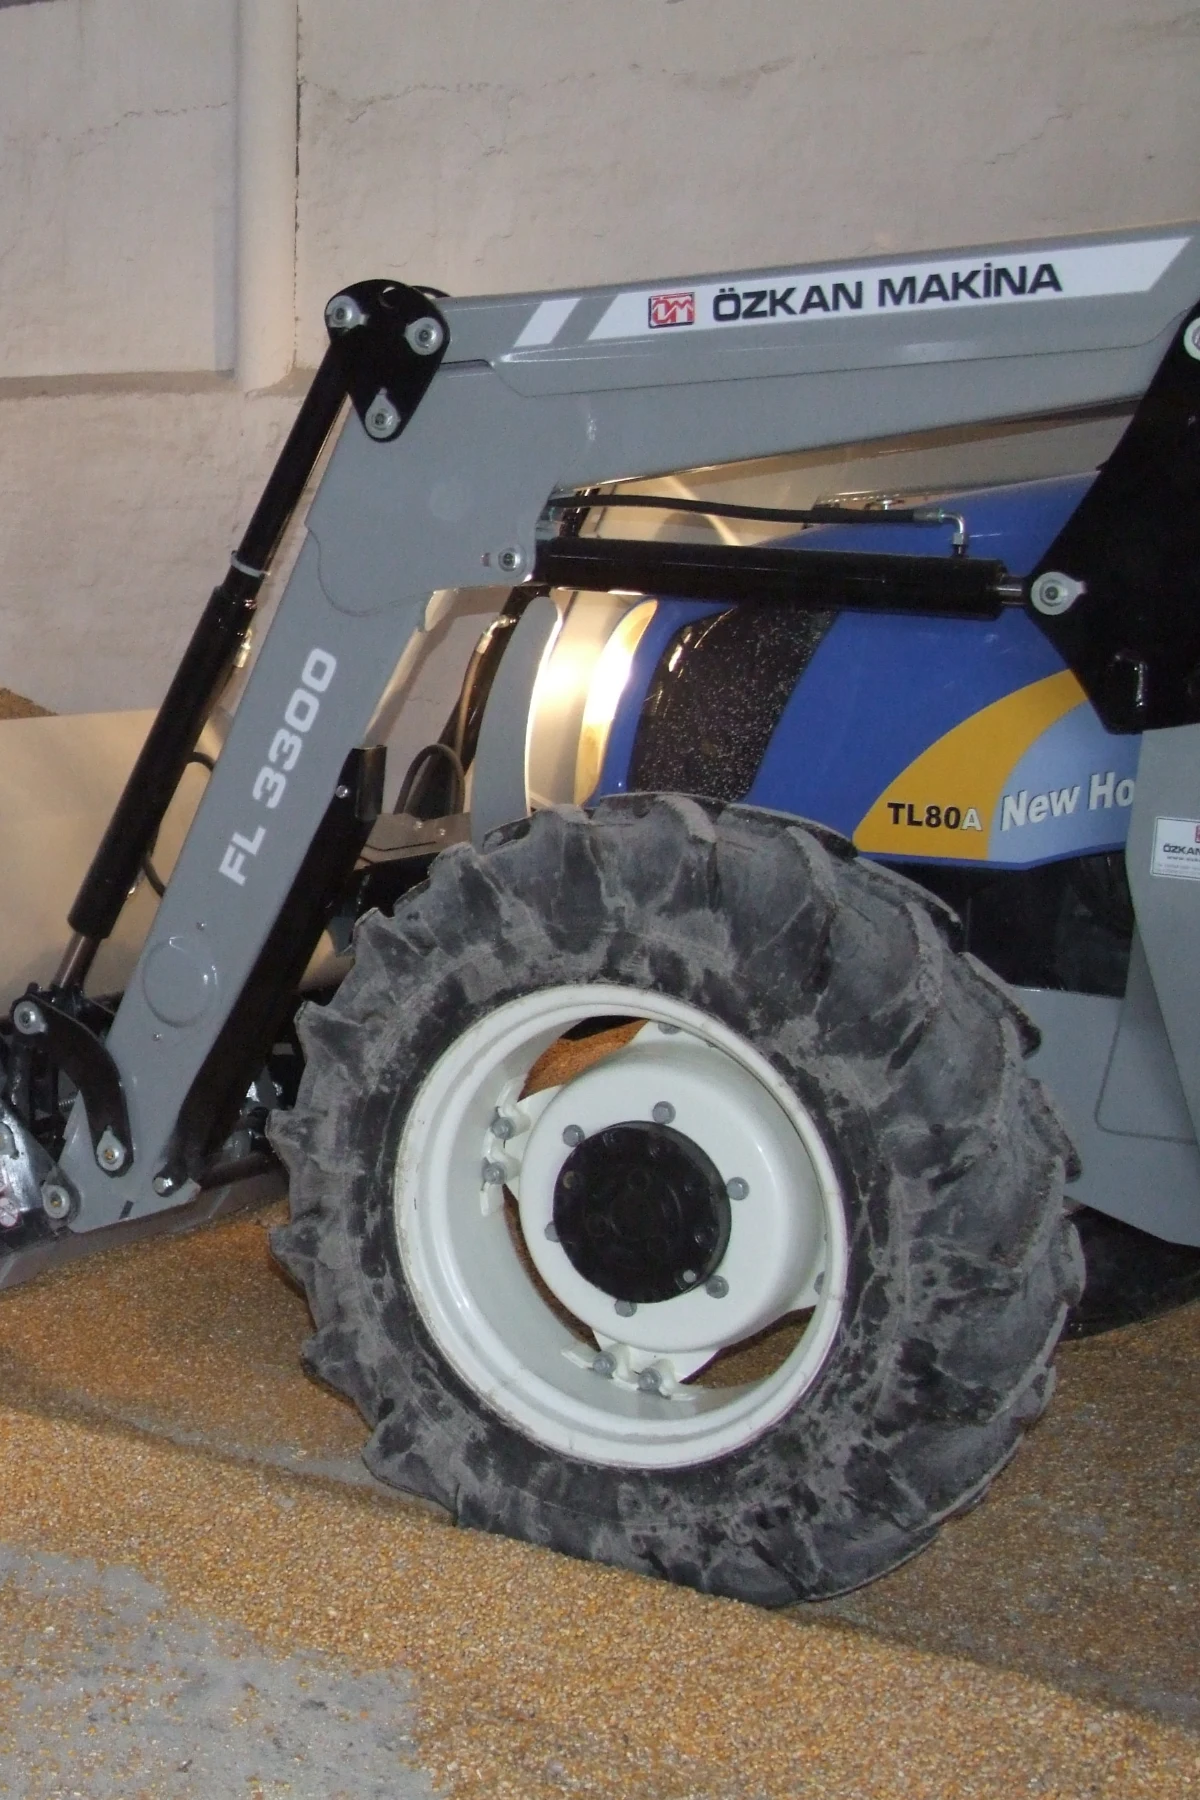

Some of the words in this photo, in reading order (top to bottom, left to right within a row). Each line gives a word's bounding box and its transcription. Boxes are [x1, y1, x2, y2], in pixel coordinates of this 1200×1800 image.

[712, 281, 863, 322] ÖZKAN
[877, 262, 1063, 309] MAKİNA
[218, 825, 266, 886] FL
[252, 648, 337, 809] 3300
[887, 802, 983, 831] TL80A
[1000, 785, 1081, 832] New
